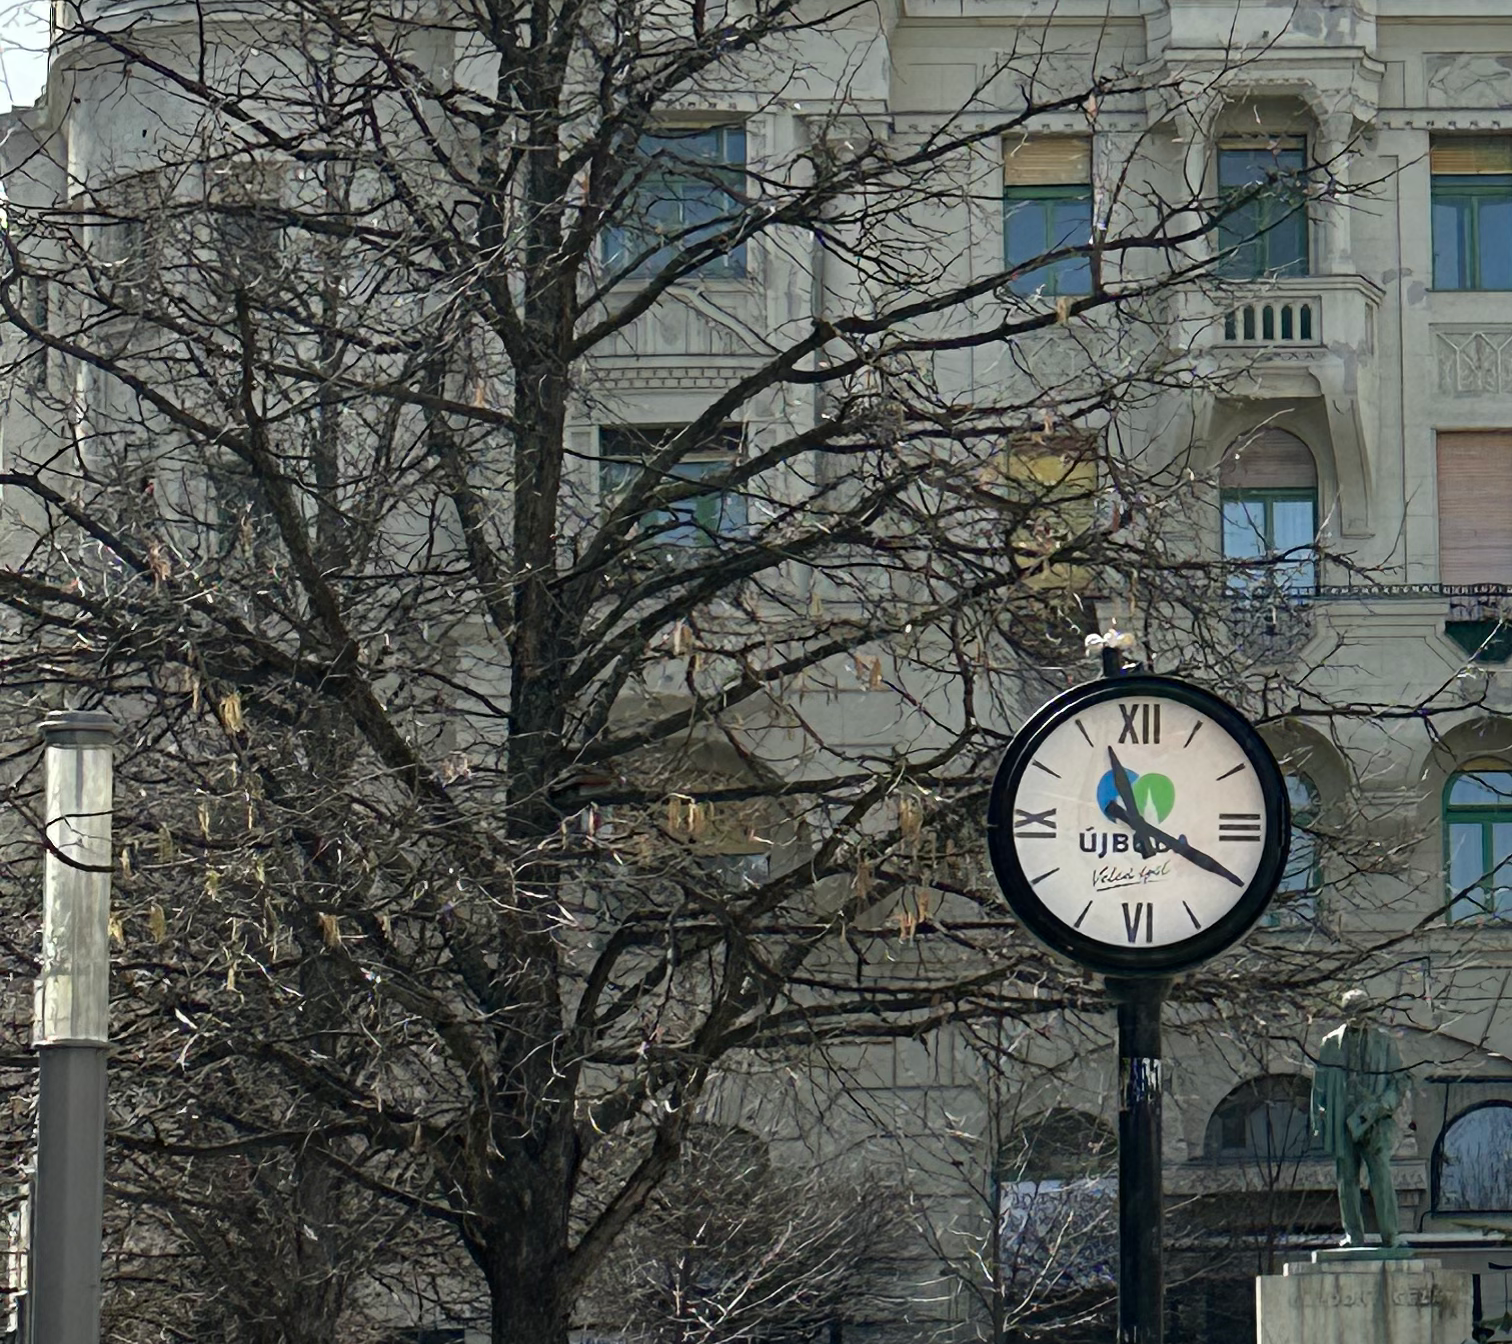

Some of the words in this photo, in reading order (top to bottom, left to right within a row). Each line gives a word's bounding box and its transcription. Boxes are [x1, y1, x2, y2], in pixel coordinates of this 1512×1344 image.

[1118, 703, 1161, 745] XII
[1218, 813, 1261, 842] III
[1121, 902, 1154, 944] VI
